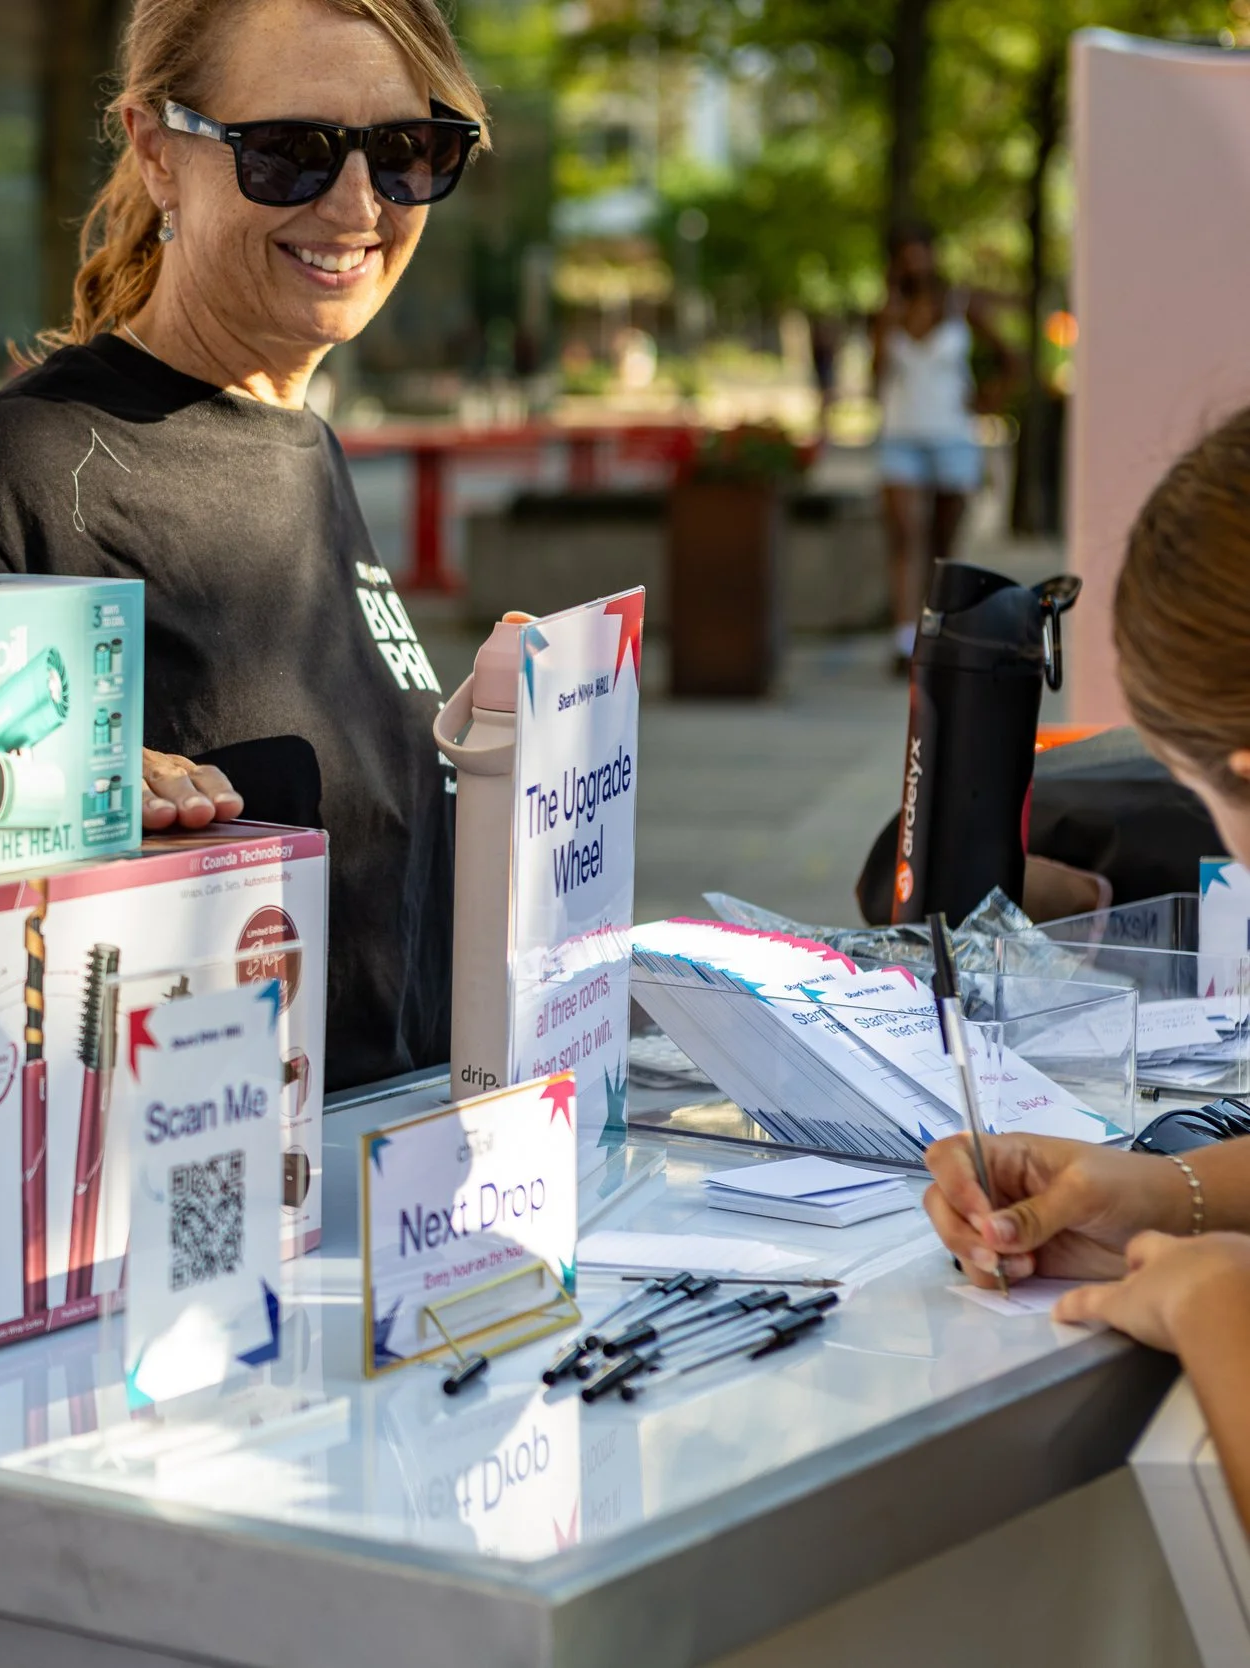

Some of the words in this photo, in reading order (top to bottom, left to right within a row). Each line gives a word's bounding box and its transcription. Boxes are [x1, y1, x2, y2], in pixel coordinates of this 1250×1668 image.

[93, 605, 102, 628] 3
[526, 783, 558, 838] The
[563, 745, 631, 829] Upgrade
[902, 736, 923, 858] ardelyx
[30, 824, 75, 856] HEAT.
[202, 852, 237, 870] Coanda
[240, 844, 293, 863] Technology
[553, 824, 604, 898] Wheel
[247, 927, 268, 938] Limited
[536, 1004, 549, 1039] all
[551, 994, 578, 1028] three
[579, 972, 611, 1012] rooms,
[854, 1012, 898, 1029] Stamp
[559, 1036, 580, 1072] spin
[582, 1029, 592, 1058] to
[594, 1015, 612, 1049] win.
[885, 1024, 918, 1038] then
[461, 1064, 500, 1090] drip.
[145, 1098, 218, 1145] Scan
[223, 1081, 269, 1125] Me
[400, 1194, 469, 1259] Next
[480, 1177, 545, 1229] Drop
